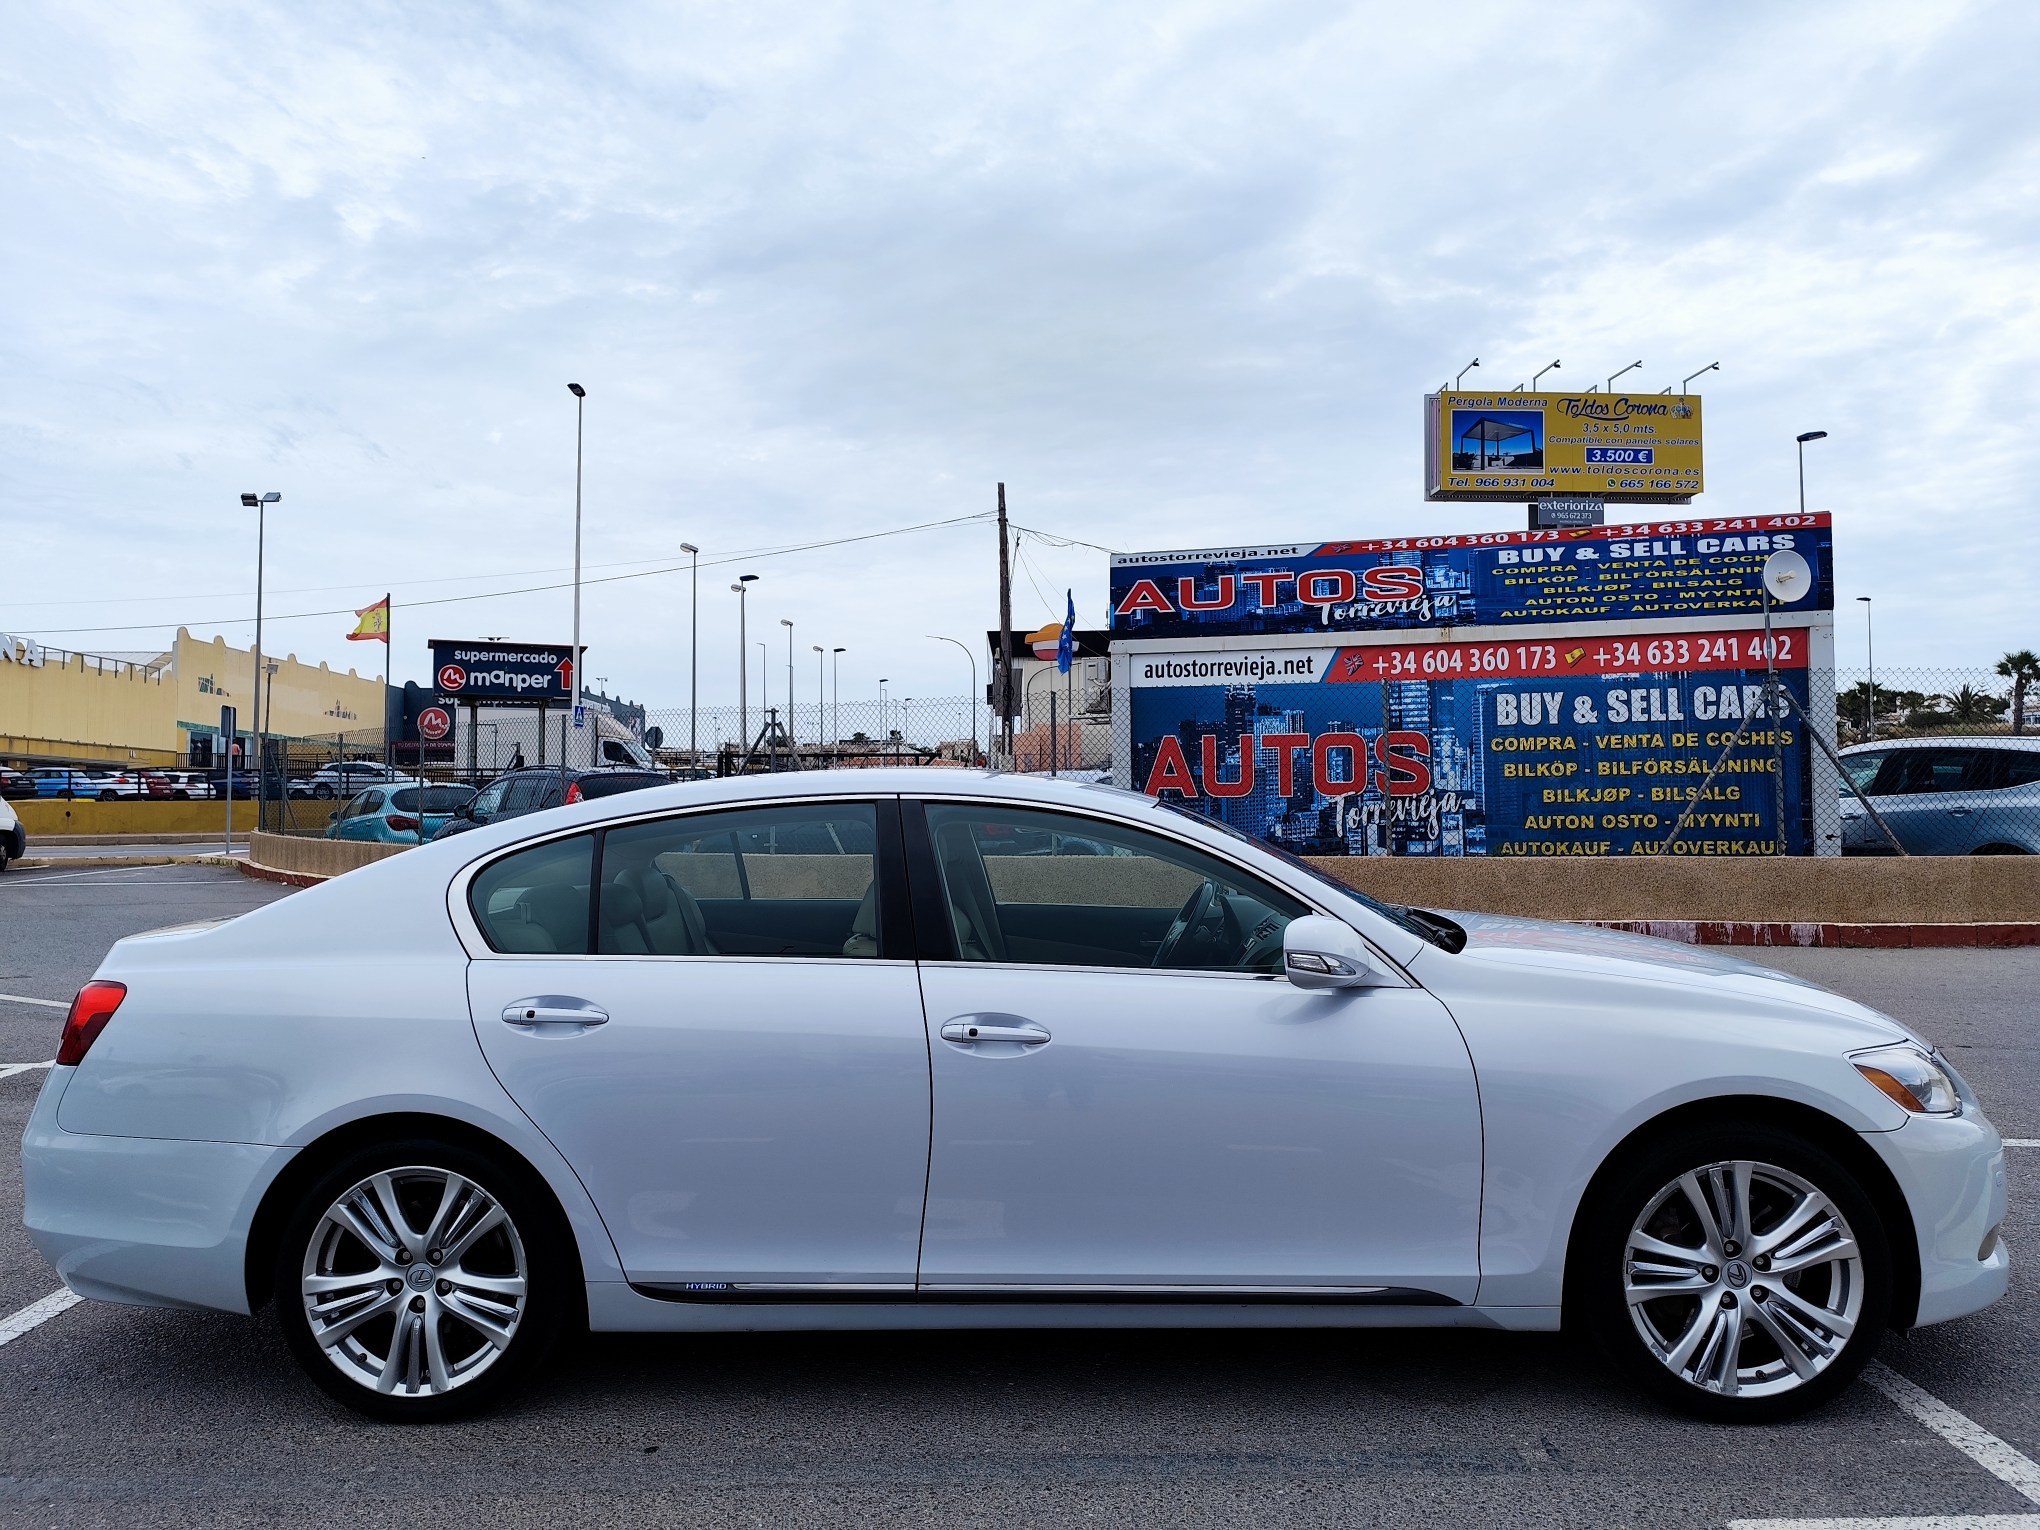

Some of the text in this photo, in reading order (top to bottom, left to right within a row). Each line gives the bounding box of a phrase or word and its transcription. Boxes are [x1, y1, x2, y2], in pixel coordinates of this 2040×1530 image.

[1448, 396, 1548, 408] Pérgola Moderna
[1557, 398, 1669, 420] Toldos Corona
[1583, 423, 1658, 434] 3,5 x 5,0 mts.
[1549, 436, 1603, 446] Compatible
[1625, 437, 1662, 446] paneles
[1665, 437, 1700, 446] solares
[1591, 449, 1649, 462] 3.500 €
[1549, 465, 1700, 475] www.toldoscorona.es
[1448, 478, 1555, 487] Tel. 966 931 004
[1620, 479, 1700, 489] 665 166 572
[1540, 500, 1604, 511] exterioriza
[1361, 515, 1816, 551] +34 604 360 173 +34 633 241 402
[1117, 546, 1299, 564] autostorrevieja.net
[1498, 534, 1796, 564] BUY & SELL CARS
[1491, 564, 1578, 575] COMPRA
[1597, 559, 1667, 570] VENTA
[1674, 558, 1701, 566] DE
[1504, 575, 1579, 585] BILKÖP
[1543, 583, 1632, 594] BILKJØP
[1652, 578, 1743, 589] BILSALG
[1115, 565, 1424, 615] AUTOS
[1525, 596, 1595, 605] AUTON
[1602, 593, 1659, 602] OSTO
[1679, 588, 1763, 599] MYYNTI
[1313, 594, 1457, 625] Torrevieja
[1500, 606, 1611, 617] AUTOKAUF
[454, 650, 558, 664] supermercado
[1372, 650, 1416, 675] +34
[1422, 648, 1464, 673] 604
[1469, 646, 1510, 671] 360
[1516, 645, 1557, 670] 173
[1593, 641, 1641, 667] +34
[1647, 639, 1690, 665] 633
[1697, 637, 1739, 663] 241
[1144, 655, 1315, 680] autostorrevieja.net
[470, 670, 552, 692] manper
[1496, 691, 1564, 726] BUY
[1573, 695, 1598, 724] &
[1606, 687, 1685, 723] SELL
[1491, 736, 1577, 751] COMPRA
[1595, 733, 1665, 749] VENTA
[1672, 732, 1699, 747] DE
[1144, 731, 1431, 798] AUTOS
[1504, 760, 1578, 777] BILKÖP
[1543, 787, 1631, 803] BILKJØP
[1651, 786, 1741, 802] BILSALG
[1334, 789, 1466, 841] Torrevieja
[1524, 815, 1595, 829] AUTON
[1602, 814, 1658, 829] OSTO
[1678, 812, 1760, 828] MYYNTI
[1501, 841, 1611, 856] AUTOKAUF
